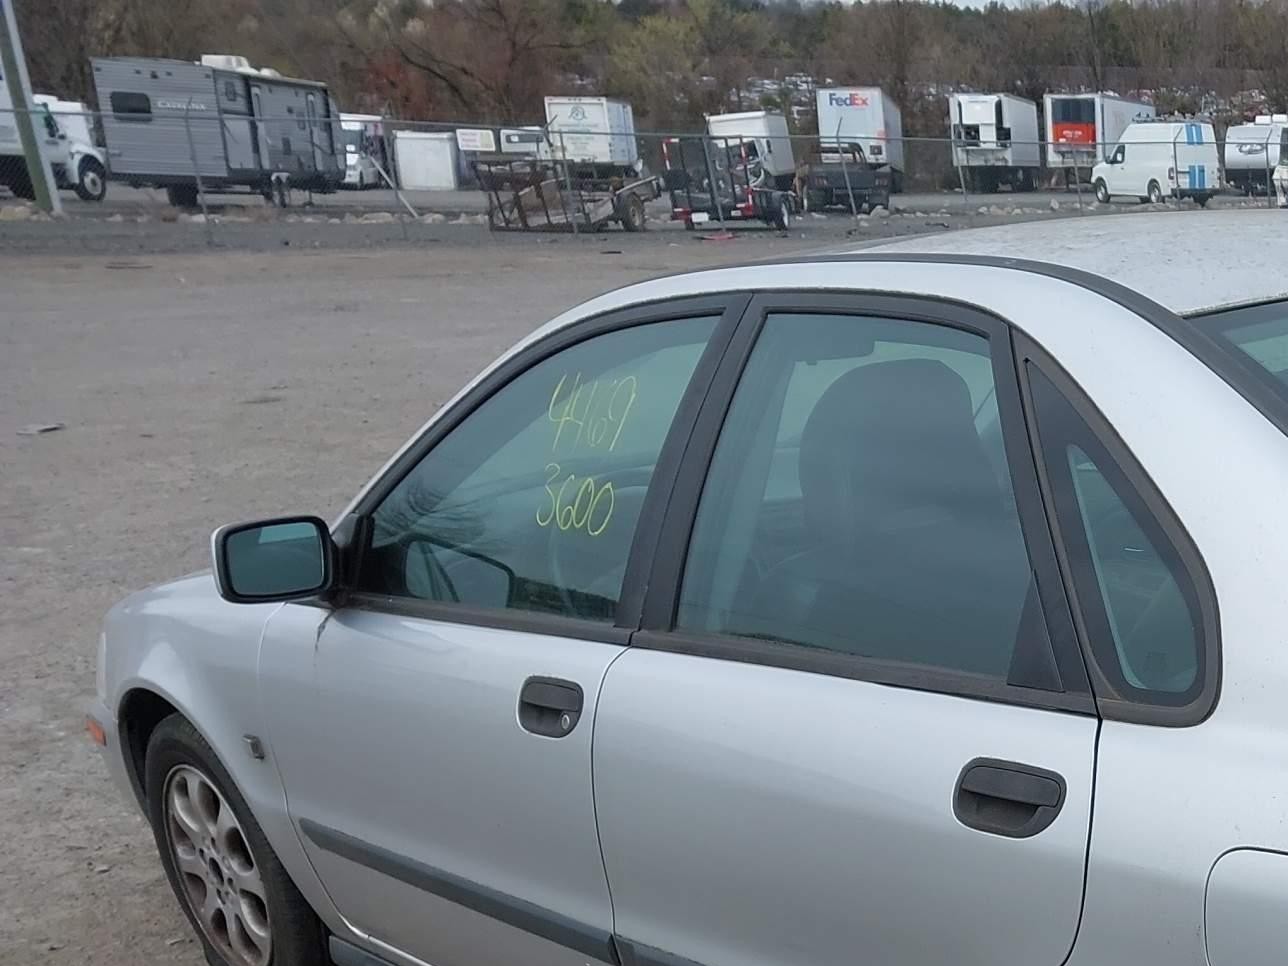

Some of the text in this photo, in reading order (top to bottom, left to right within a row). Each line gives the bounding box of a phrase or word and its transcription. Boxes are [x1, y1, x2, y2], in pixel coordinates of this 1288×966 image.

[828, 92, 869, 106] FedEx
[548, 371, 637, 452] 4469
[536, 462, 615, 536] 3600
